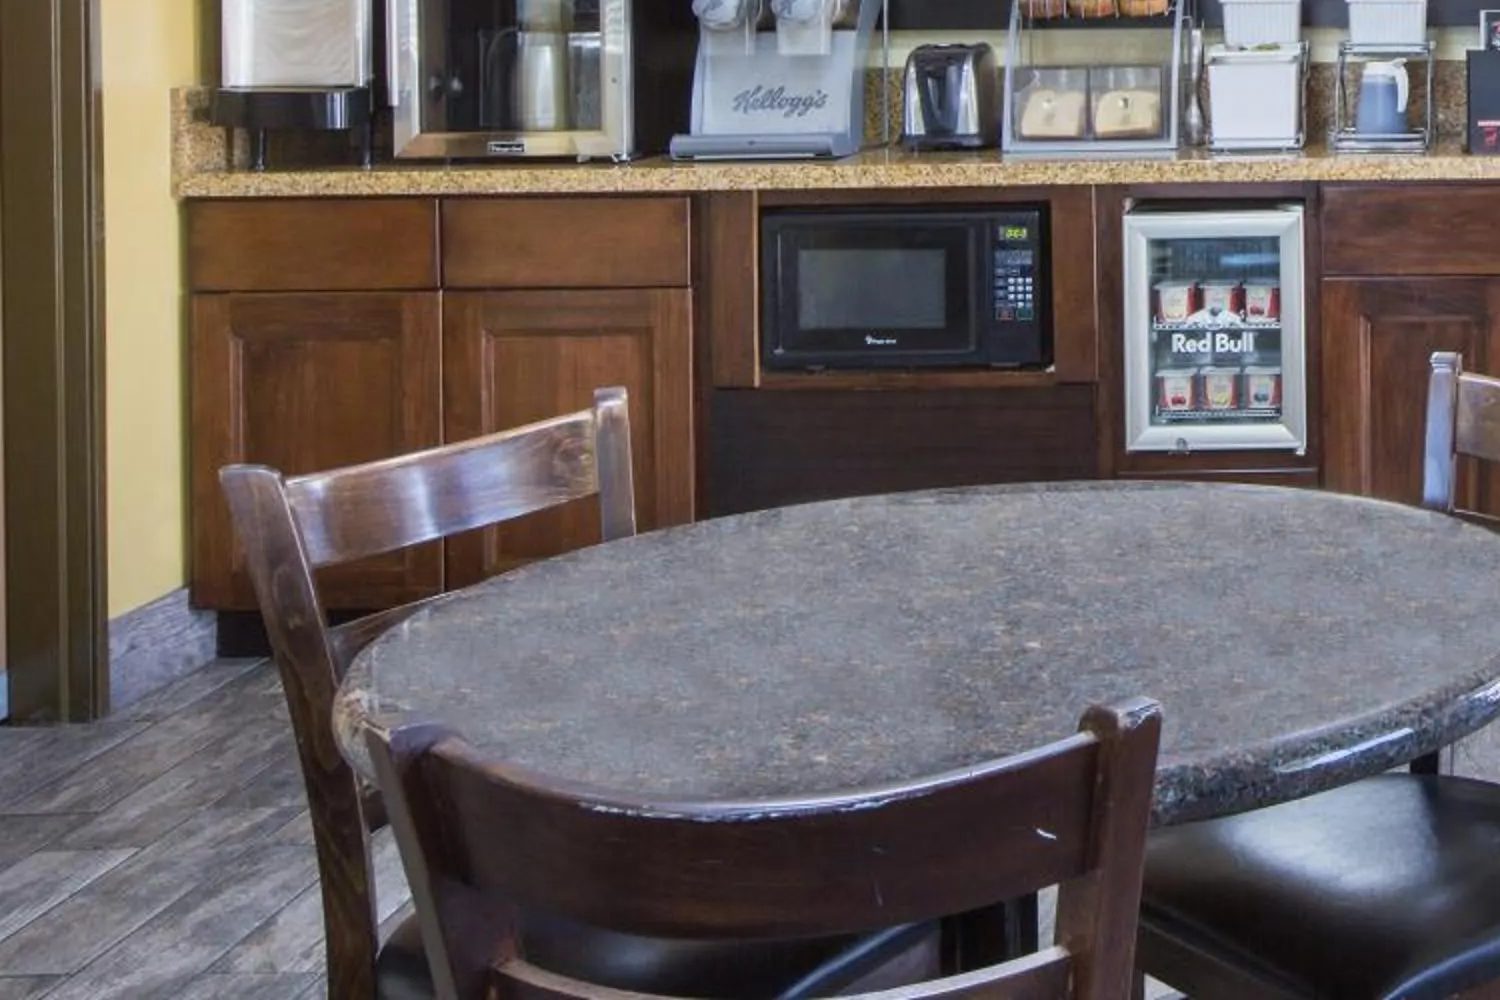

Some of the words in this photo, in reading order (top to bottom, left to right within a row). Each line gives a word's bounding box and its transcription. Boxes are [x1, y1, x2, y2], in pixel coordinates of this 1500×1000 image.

[732, 84, 829, 119] Kellogg's
[1171, 331, 1213, 354] Red
[1215, 331, 1254, 354] Bull
